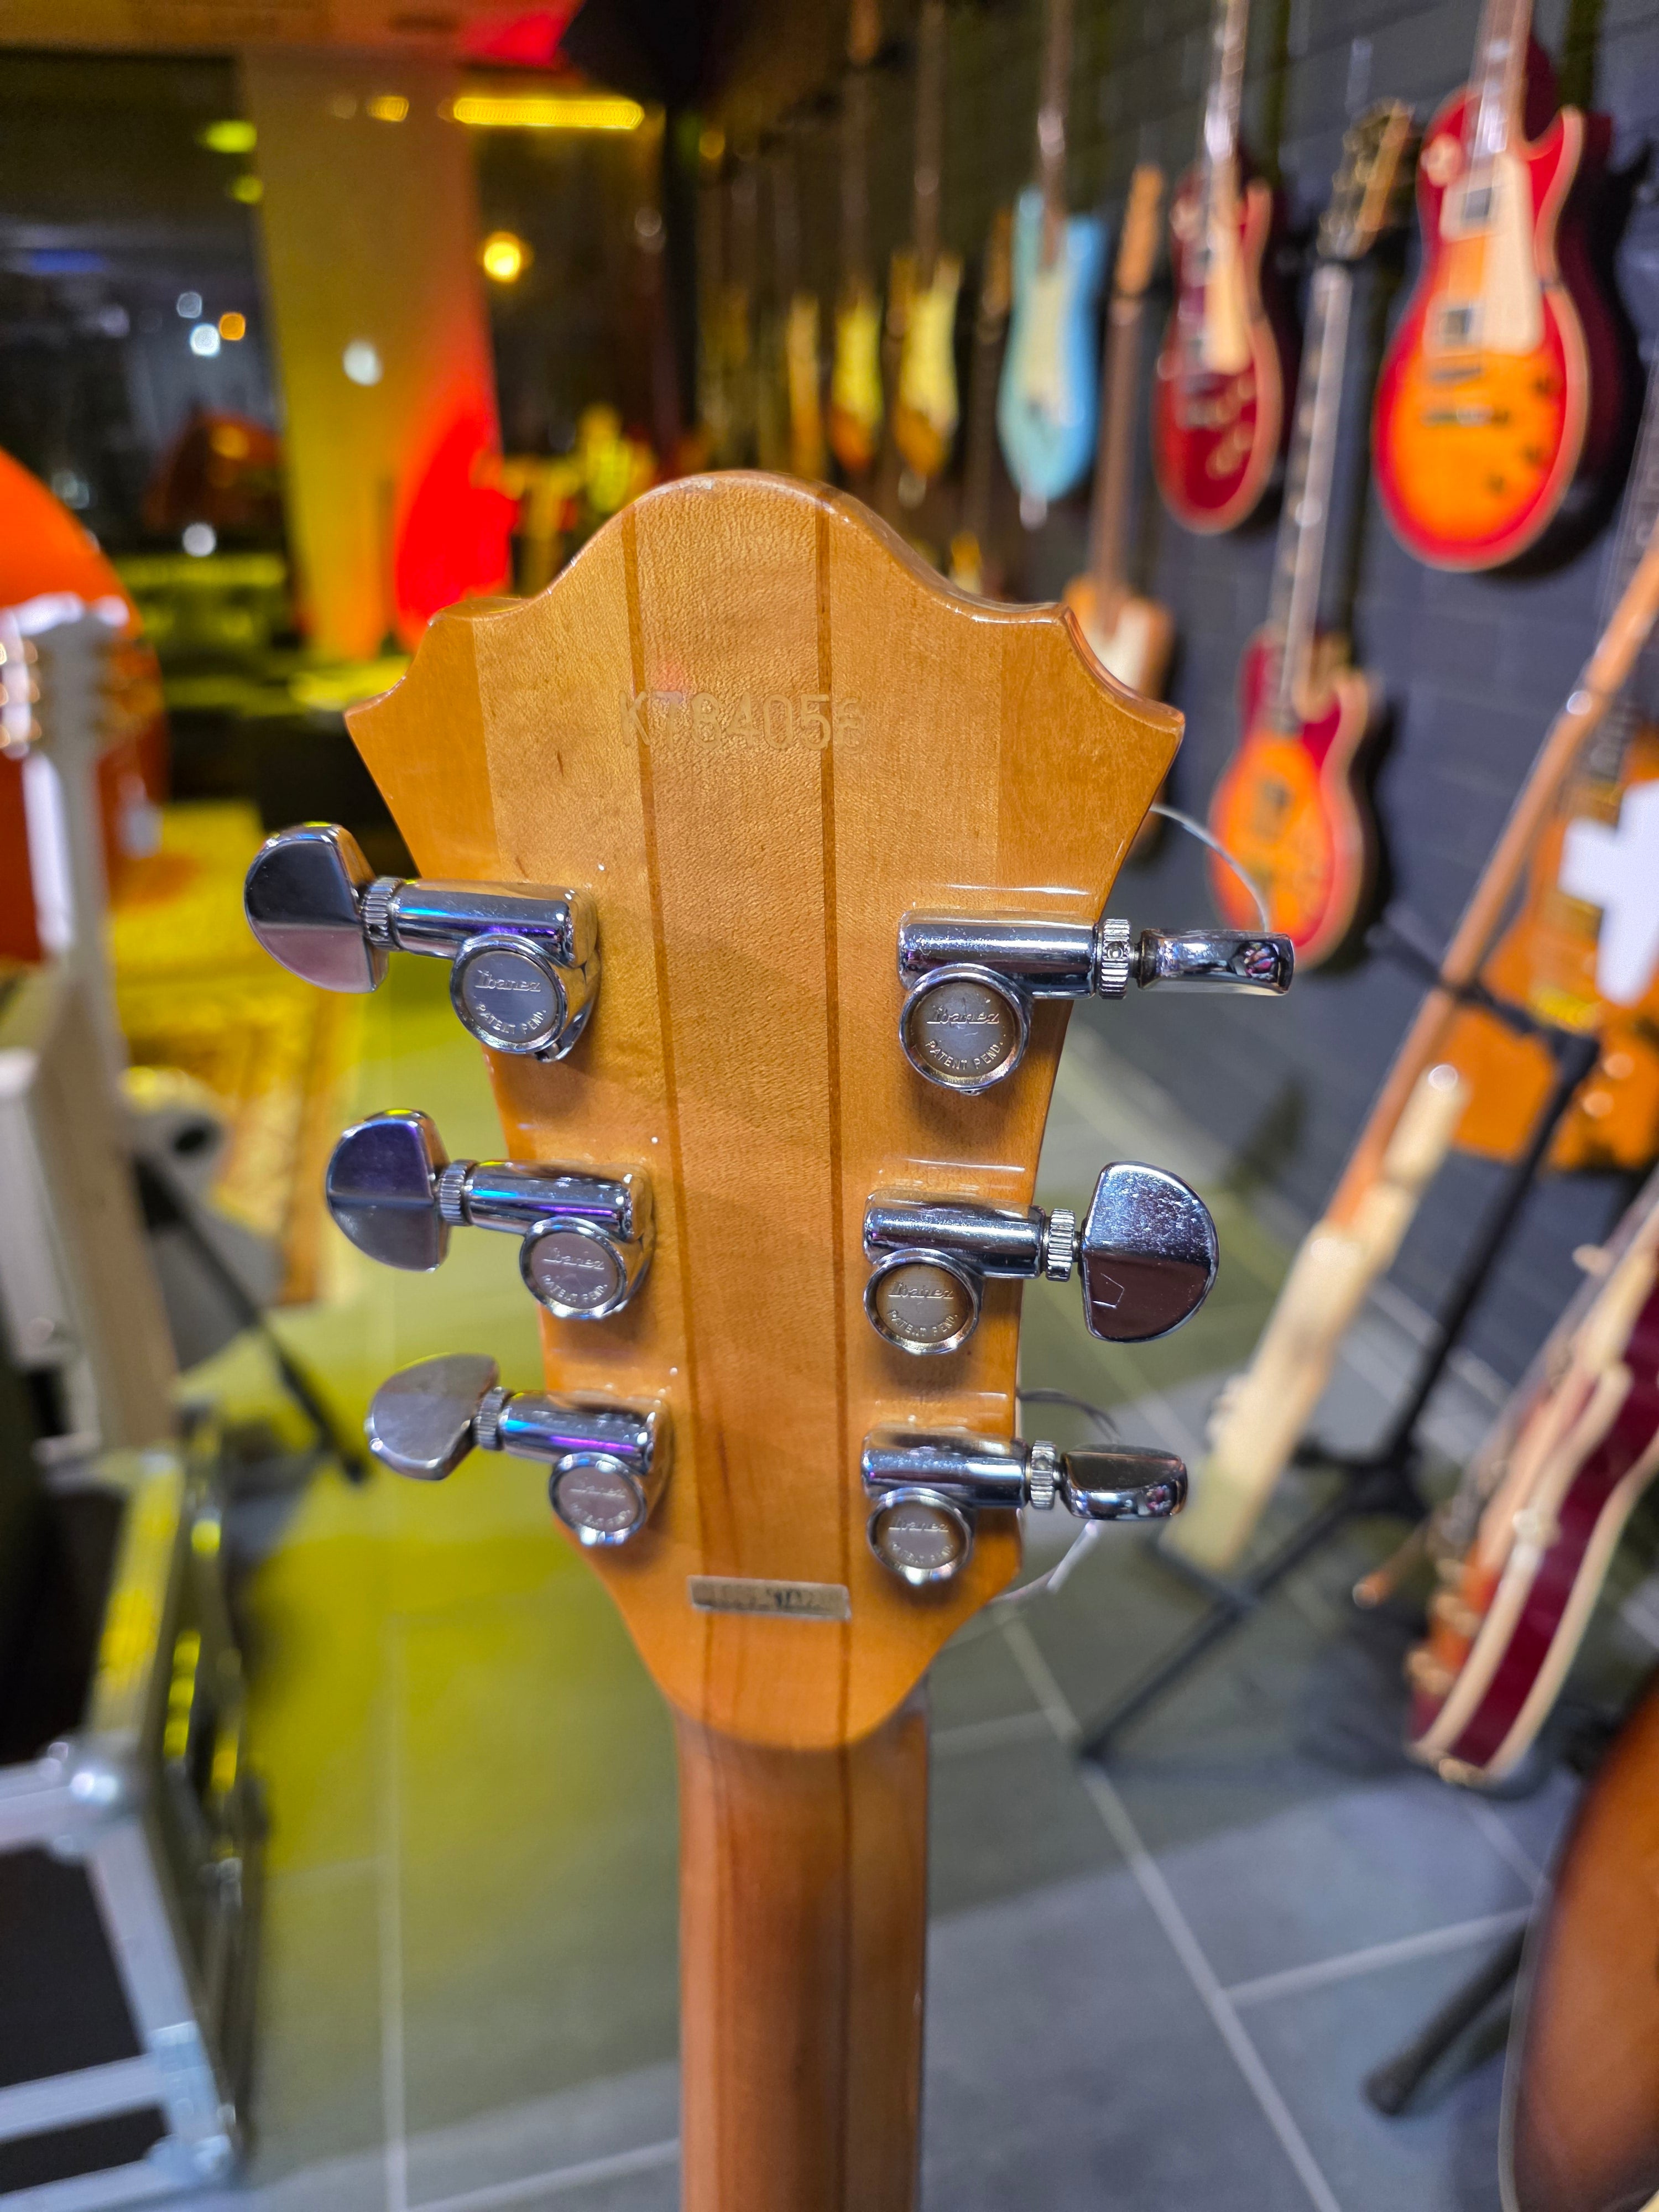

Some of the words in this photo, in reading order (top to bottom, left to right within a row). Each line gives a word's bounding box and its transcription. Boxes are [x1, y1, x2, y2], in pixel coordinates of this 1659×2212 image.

[475, 970, 541, 992] Ibanez
[926, 1005, 1000, 1024] Ibanez
[925, 1040, 968, 1070] PATENT
[888, 1281, 954, 1300] Ibanez
